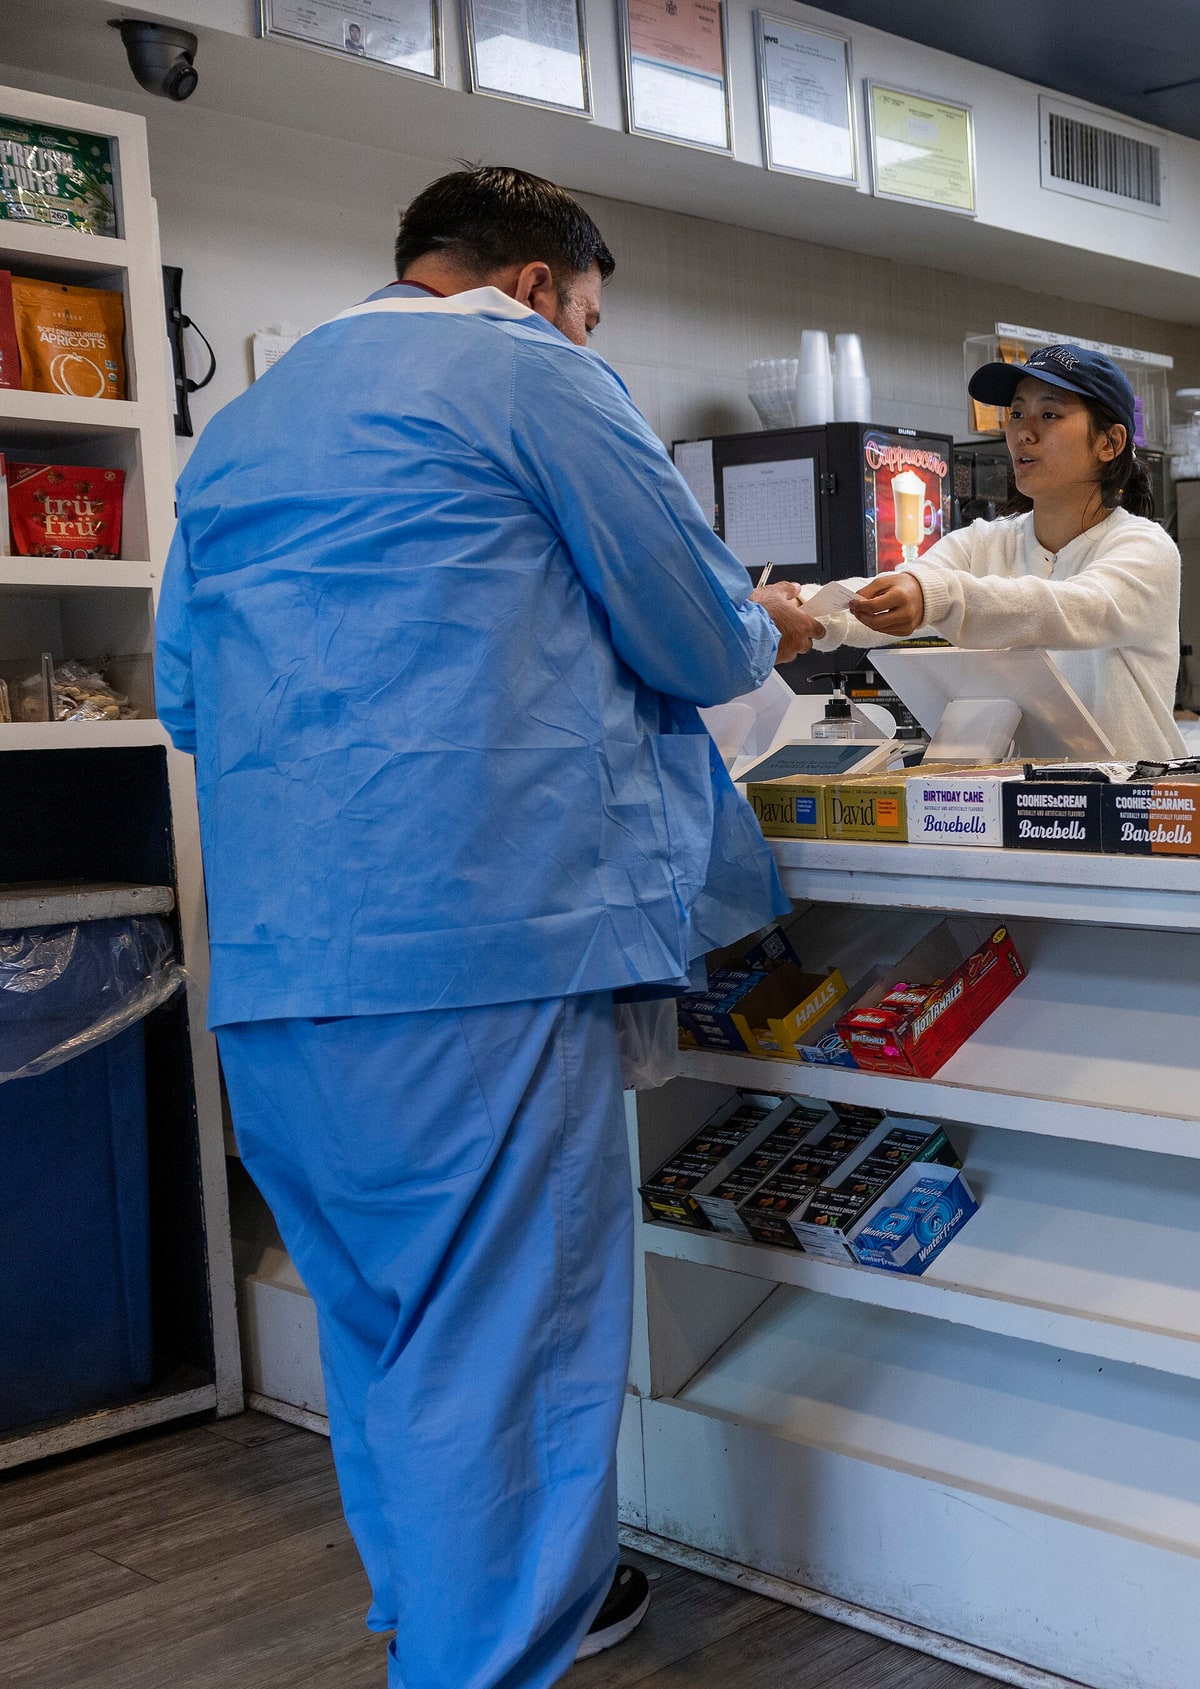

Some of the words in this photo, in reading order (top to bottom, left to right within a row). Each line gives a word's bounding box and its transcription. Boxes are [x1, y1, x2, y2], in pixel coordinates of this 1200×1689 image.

[51, 210, 69, 221] 260
[37, 325, 55, 334] SOFT
[55, 328, 76, 337] DRIED
[76, 330, 106, 339] TURKISH
[54, 322, 86, 332] ORGANIC
[40, 332, 107, 350] APRICOTS
[898, 428, 916, 436] BUNN
[866, 440, 948, 478] Cappuccino
[44, 495, 95, 516] trü
[43, 514, 97, 536] frü
[924, 790, 960, 803] BIRTHDAY
[963, 791, 984, 804] CAKE
[752, 796, 795, 823] David
[832, 798, 876, 826] David
[924, 814, 986, 834] Barebells
[1019, 820, 1086, 840] Barebells
[1120, 822, 1192, 844] Barebells
[795, 982, 838, 1028] HALLS
[842, 1207, 857, 1215] DROPS
[861, 1227, 902, 1241] Winterfres
[918, 1208, 964, 1262] Winterfresh
